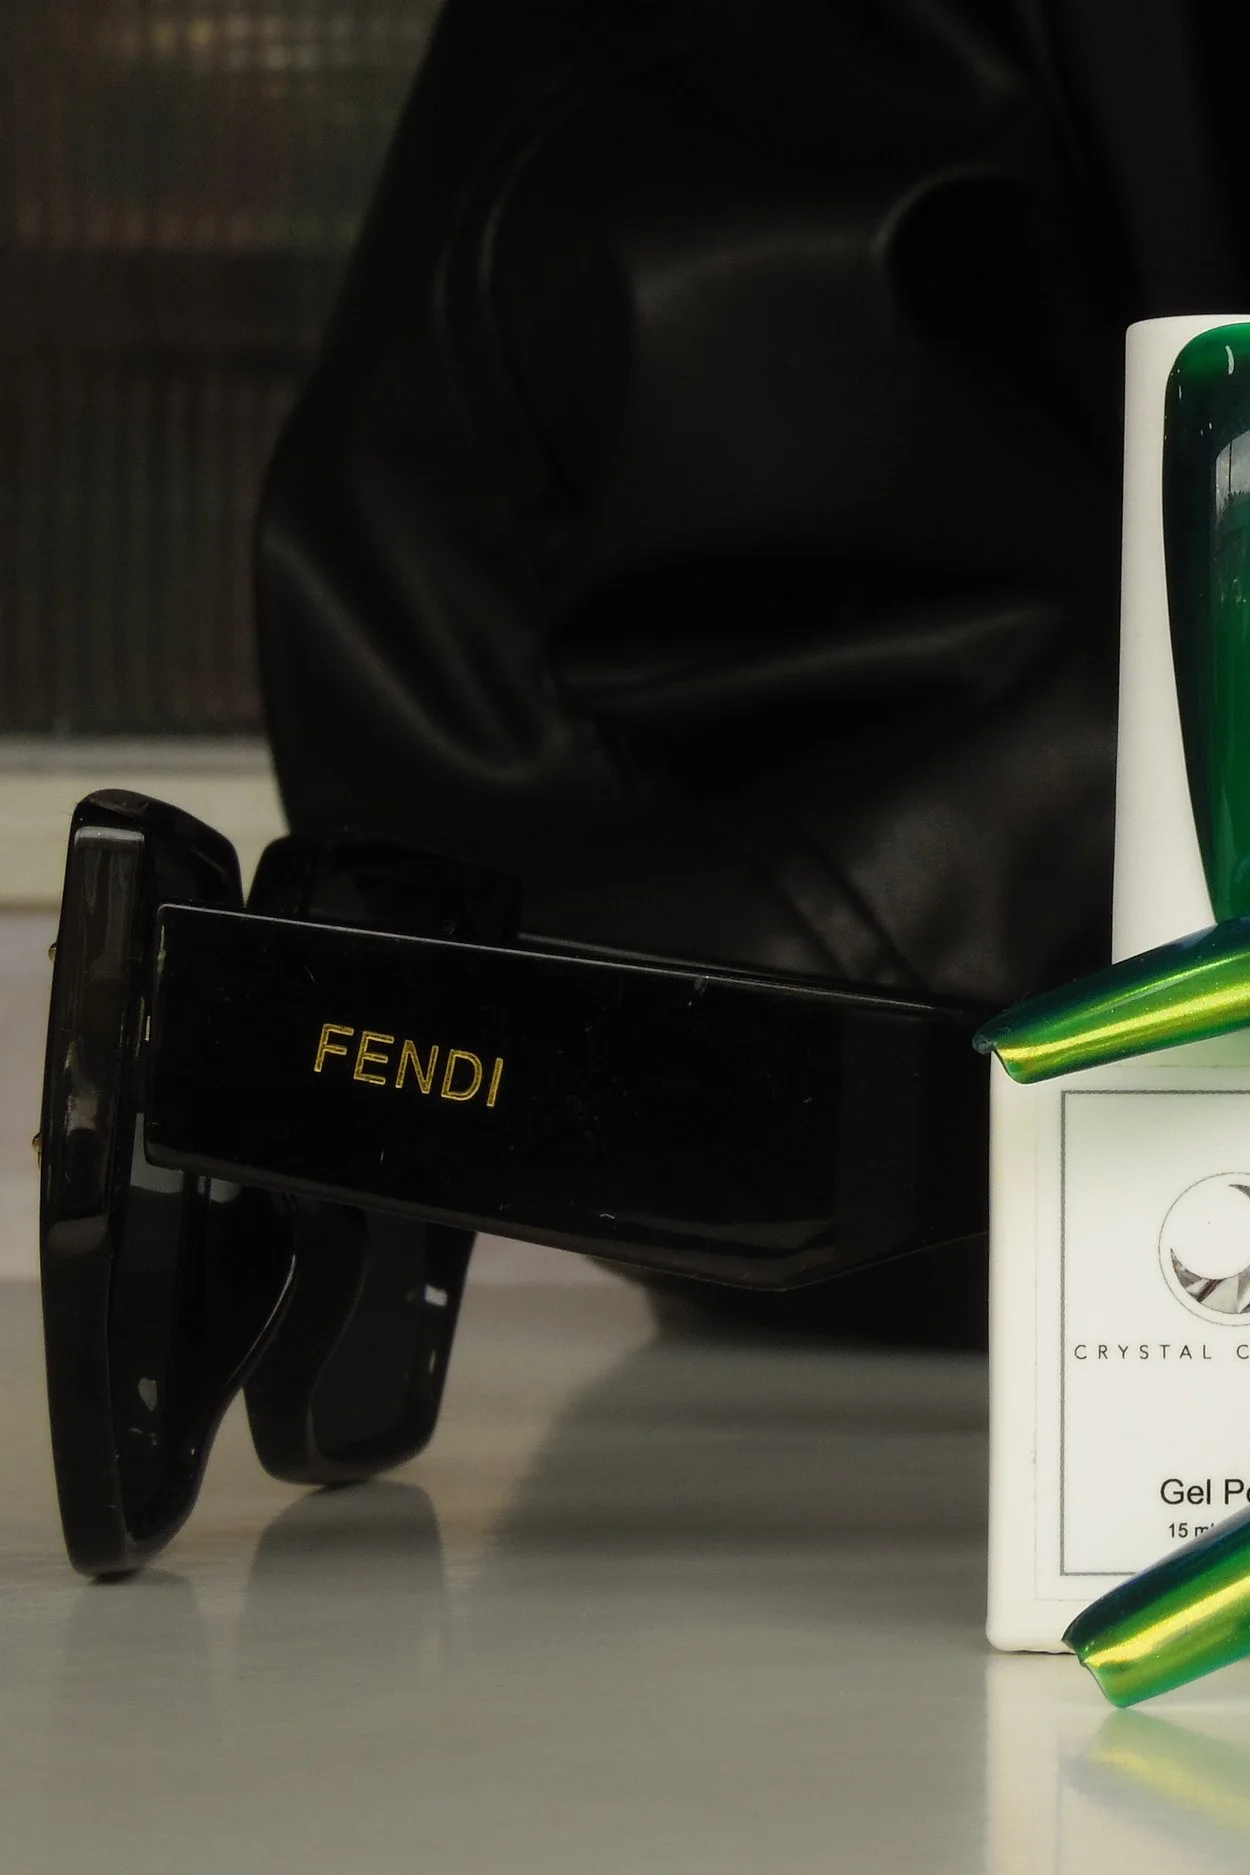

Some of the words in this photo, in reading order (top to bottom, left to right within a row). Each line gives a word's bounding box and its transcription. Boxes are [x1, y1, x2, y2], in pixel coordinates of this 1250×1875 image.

[313, 1022, 504, 1107] FENDI
[1073, 1344, 1213, 1360] CRYSTAL
[1160, 1478, 1211, 1505] Gel
[1168, 1522, 1188, 1538] 15
